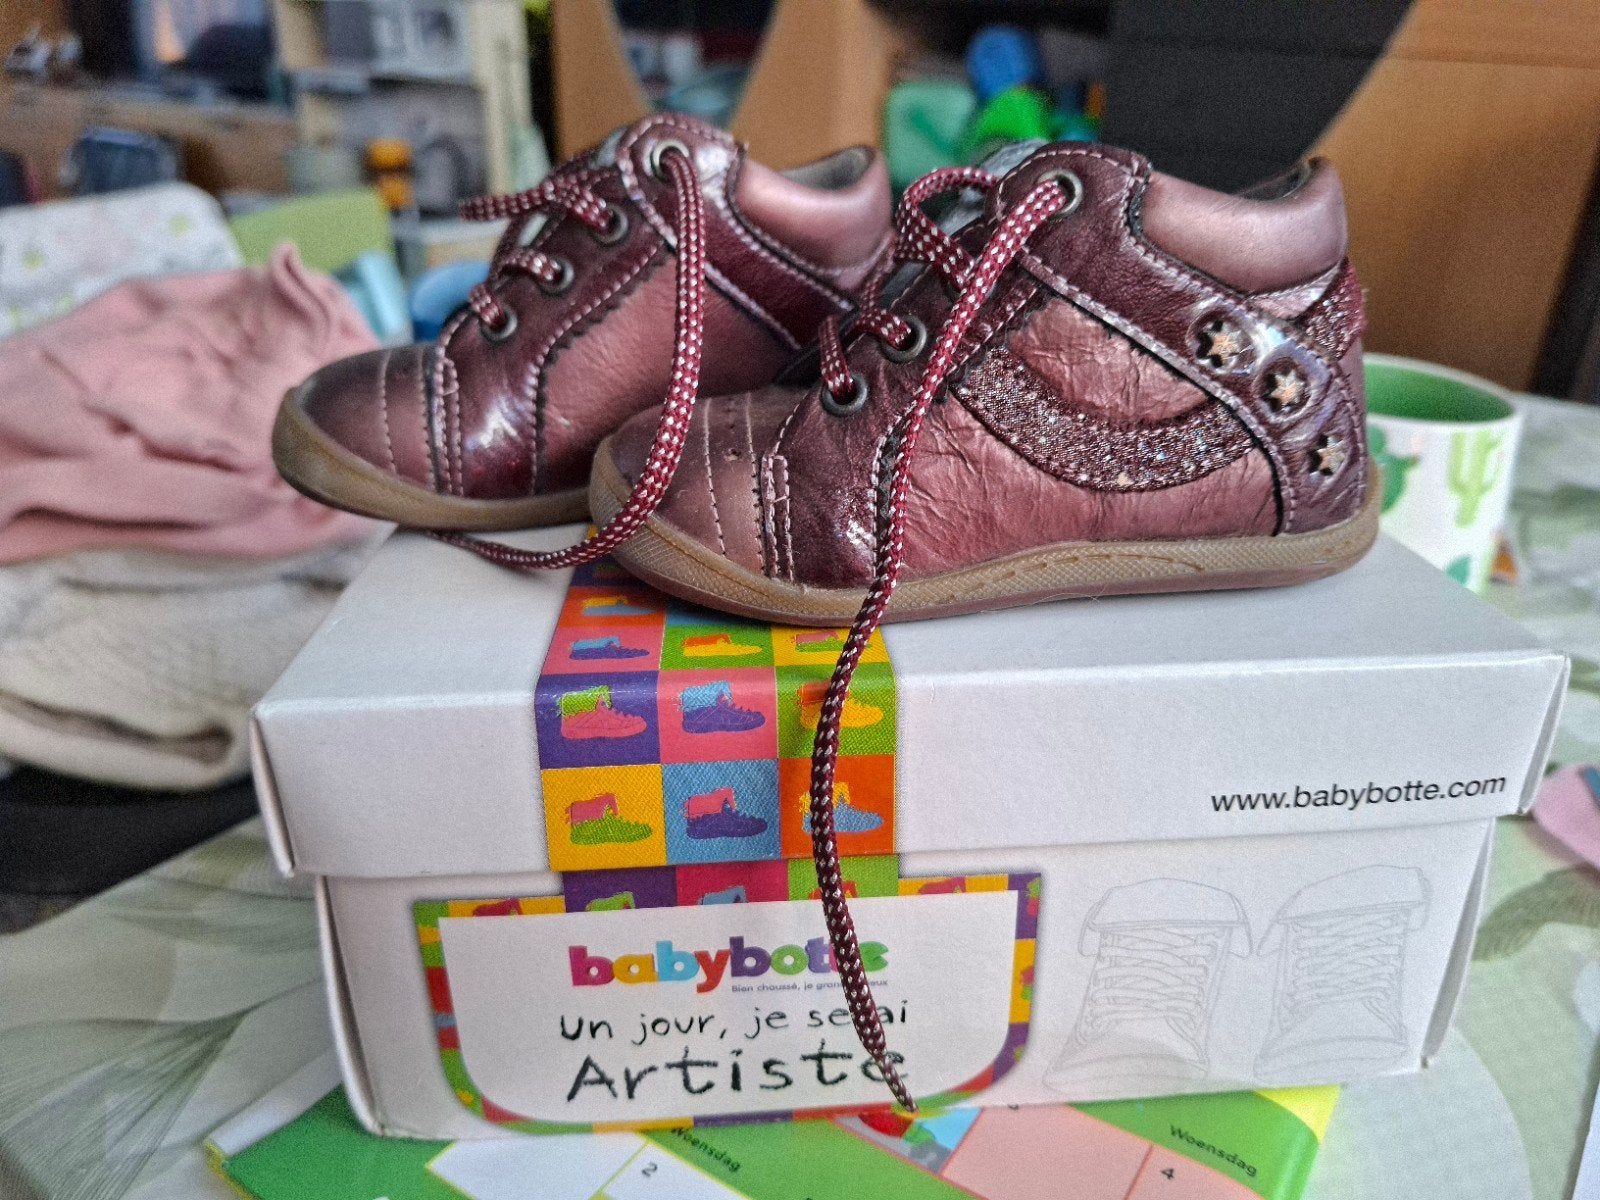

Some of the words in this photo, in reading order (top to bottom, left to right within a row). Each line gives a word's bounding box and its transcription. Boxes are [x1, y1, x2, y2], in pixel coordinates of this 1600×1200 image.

[1211, 776, 1506, 811] www.babybotte.com
[568, 936, 889, 993] babybote
[731, 984, 754, 993] Bien
[631, 1013, 727, 1046] jour,
[744, 1006, 789, 1040] je
[807, 999, 908, 1027] seai
[1170, 1124, 1257, 1178] Woensdag
[641, 1162, 658, 1178] 2
[1160, 1167, 1175, 1181] 4
